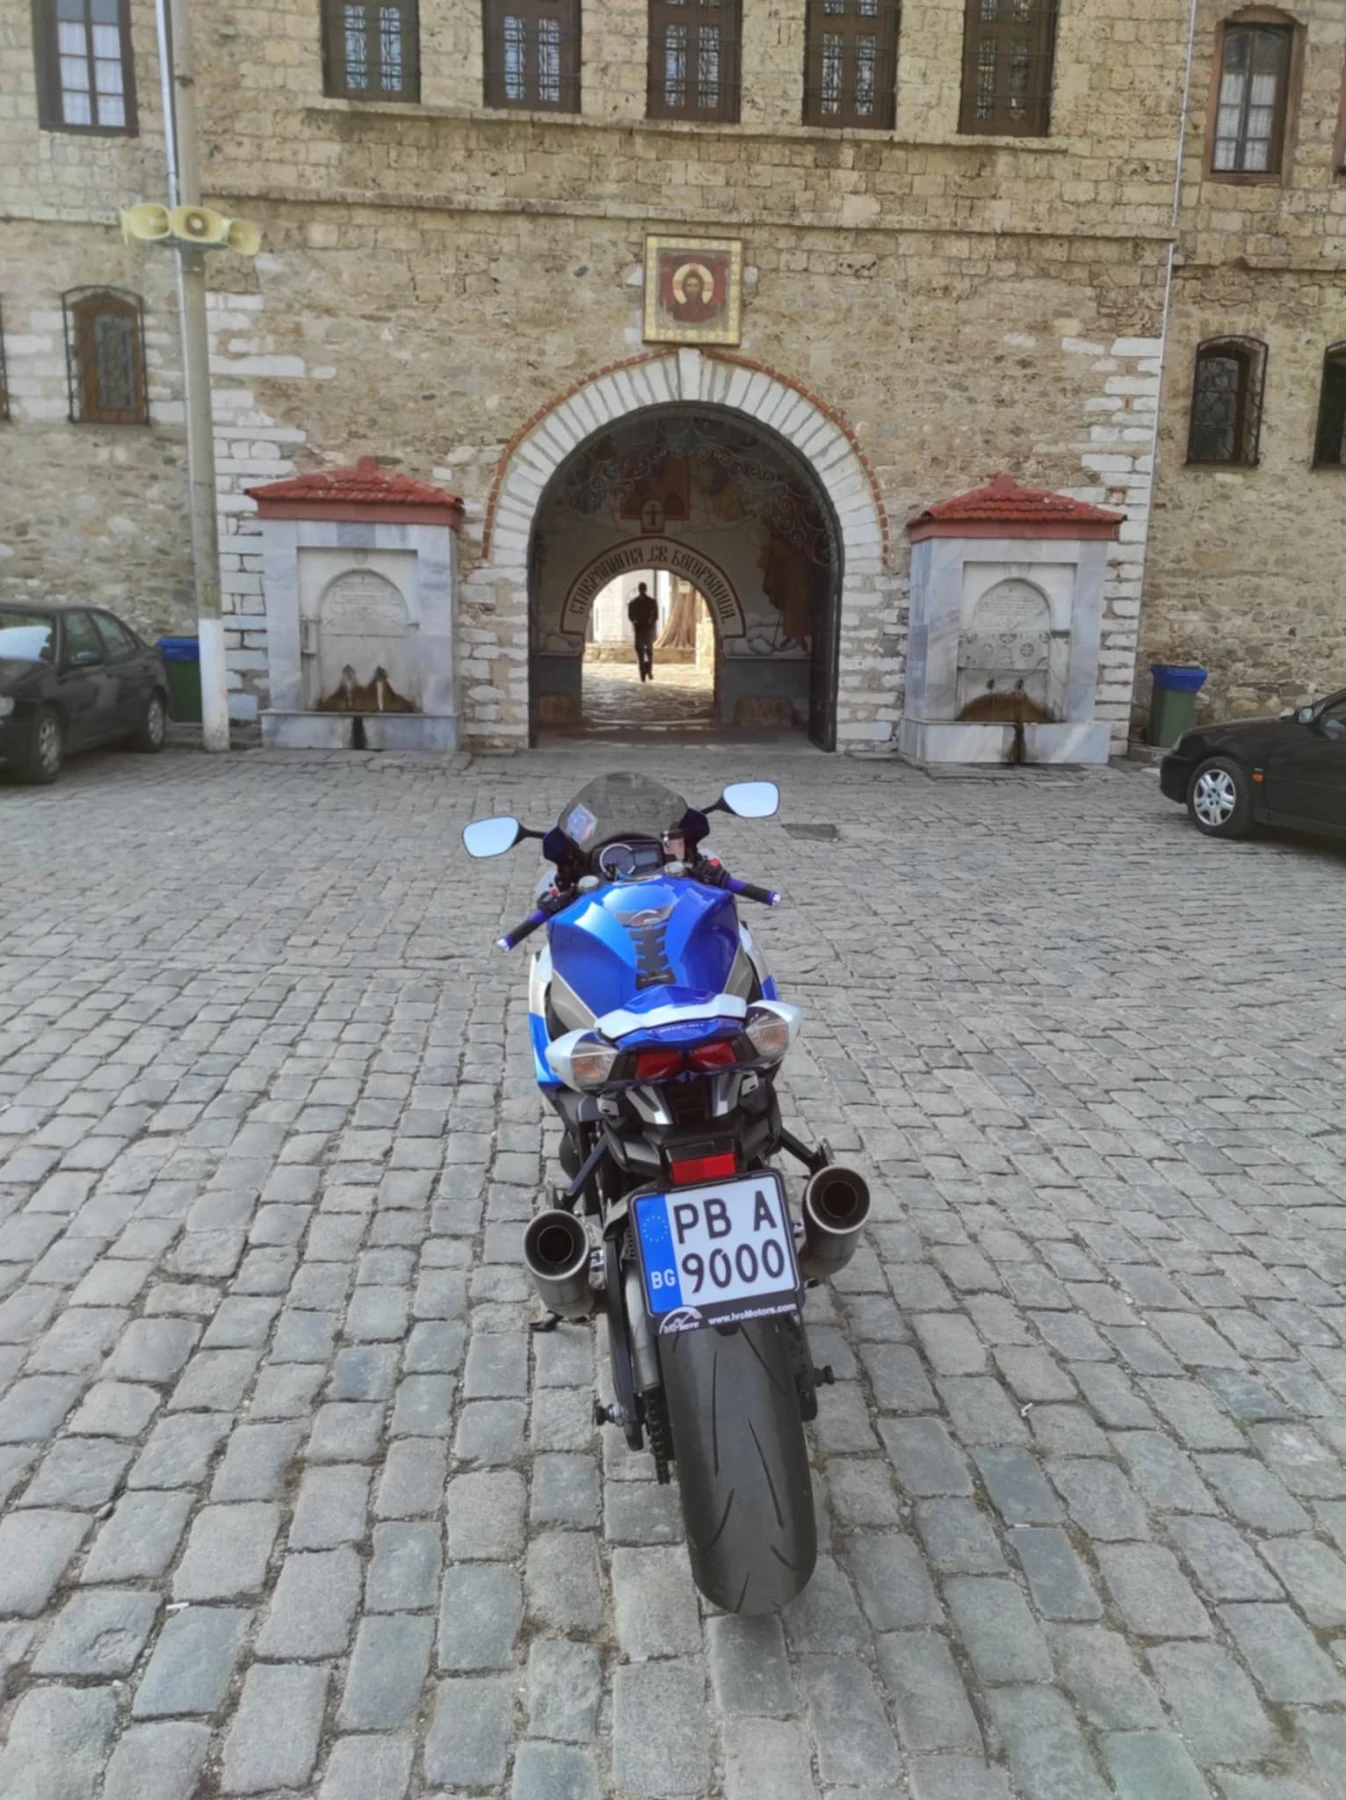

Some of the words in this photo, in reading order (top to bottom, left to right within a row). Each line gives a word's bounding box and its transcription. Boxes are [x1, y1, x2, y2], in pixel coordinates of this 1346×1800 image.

[673, 1198, 732, 1245] PB
[753, 1190, 777, 1232] A
[651, 1269, 676, 1289] BG
[681, 1238, 785, 1293] 9000
